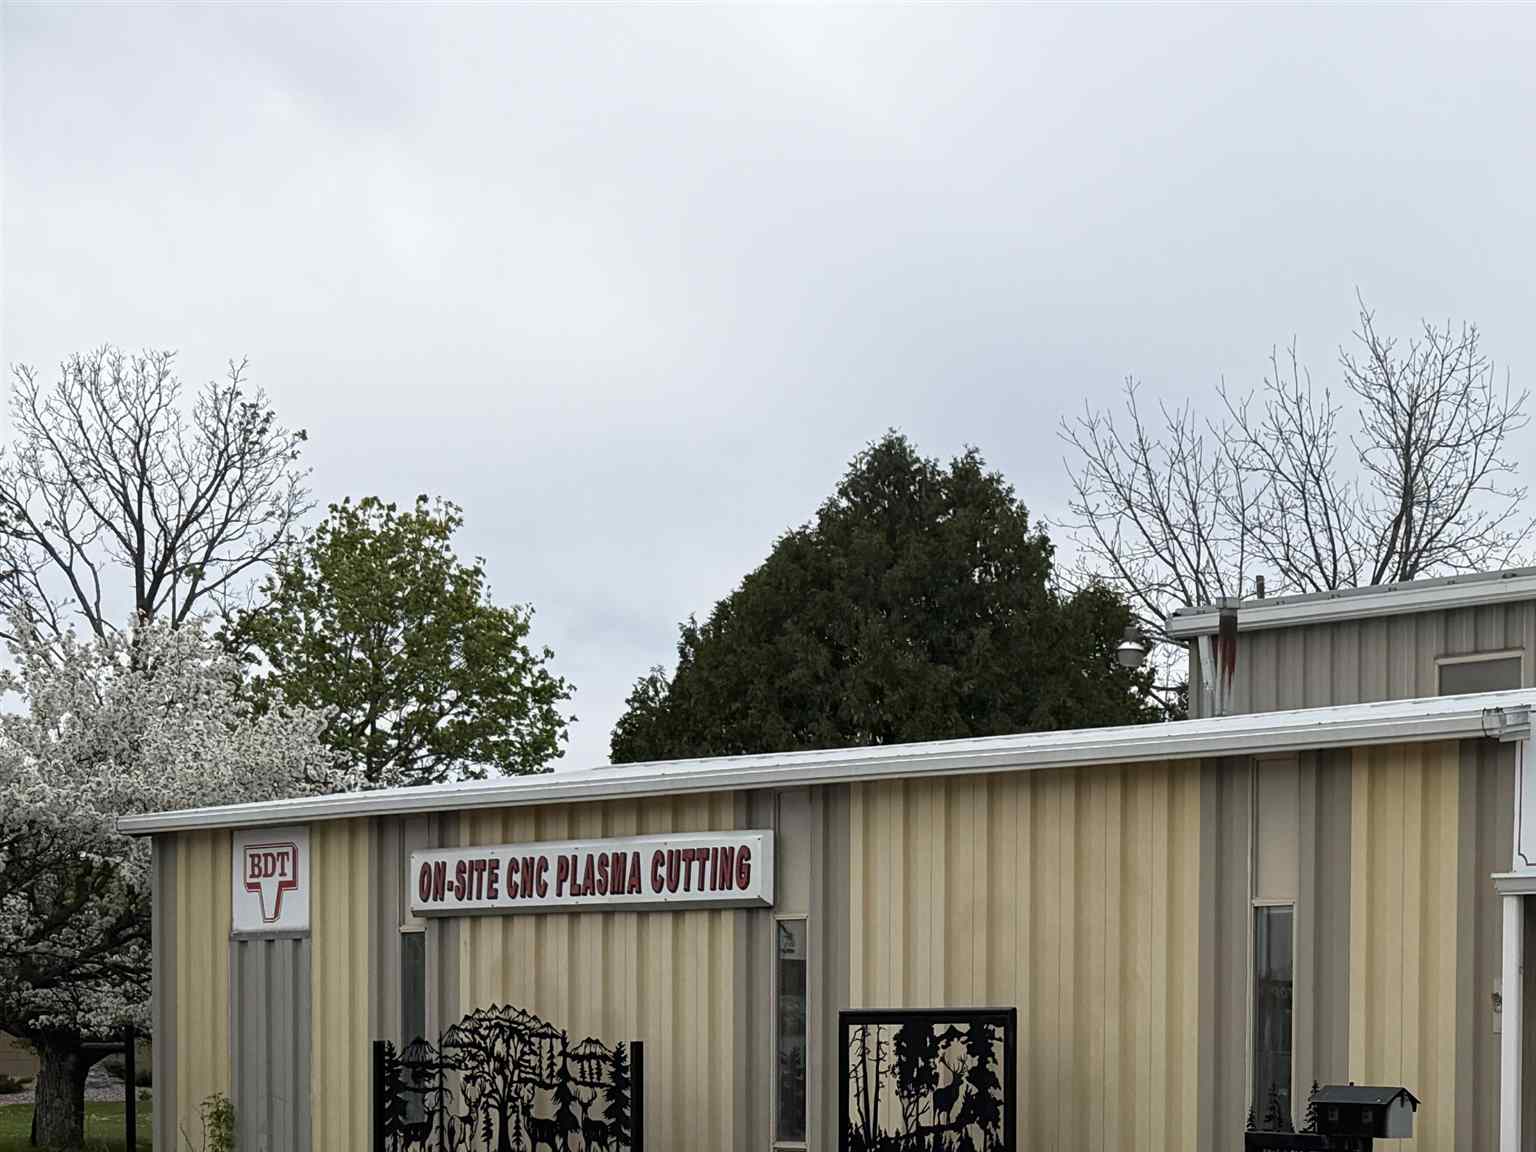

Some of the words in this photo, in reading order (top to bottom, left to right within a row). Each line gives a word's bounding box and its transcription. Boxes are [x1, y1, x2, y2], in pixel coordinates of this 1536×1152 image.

[249, 851, 290, 879] BDT
[419, 858, 500, 903] ON-SITE
[506, 855, 549, 900] CNC
[556, 851, 642, 898] PLASMA
[651, 845, 752, 894] CUTTING
